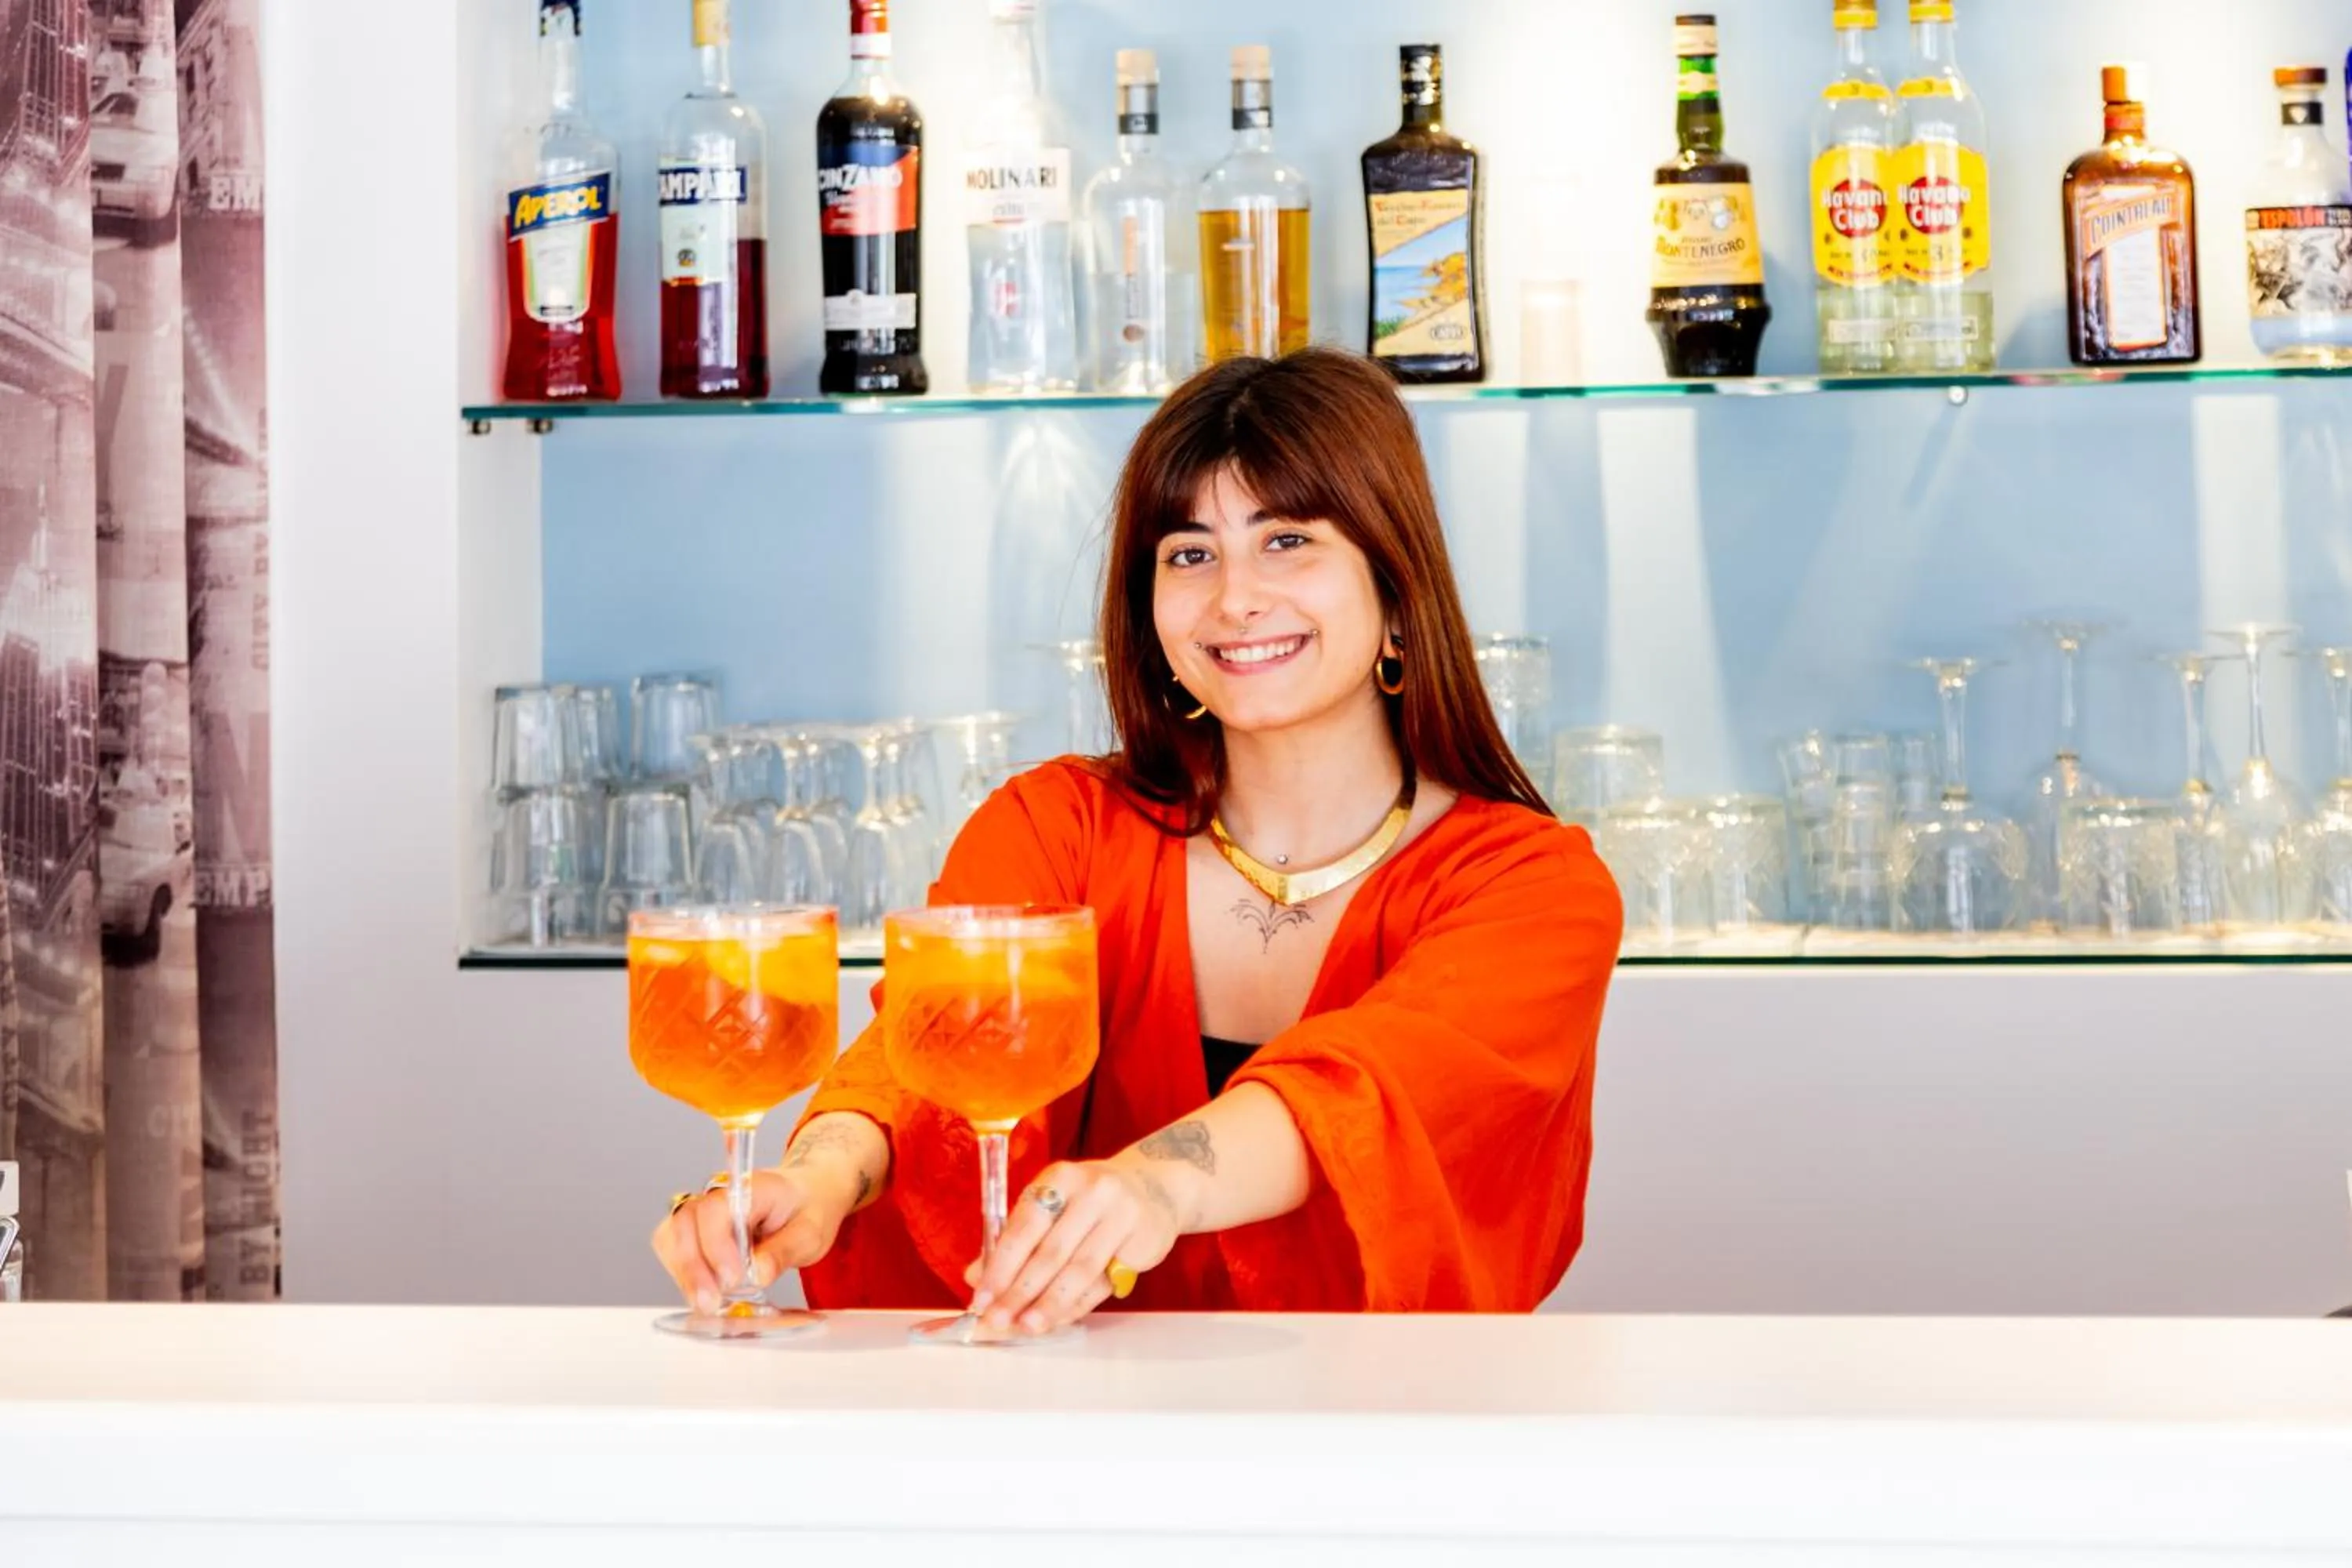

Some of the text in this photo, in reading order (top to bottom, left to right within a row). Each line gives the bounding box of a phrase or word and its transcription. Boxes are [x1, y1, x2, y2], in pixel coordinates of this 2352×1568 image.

[659, 169, 742, 201] AMPARI
[967, 166, 1057, 190] MOLINARI
[514, 185, 602, 228] APEROL
[1897, 184, 1971, 205] Havana
[1833, 206, 1880, 232] Club
[1910, 203, 1958, 228] Club
